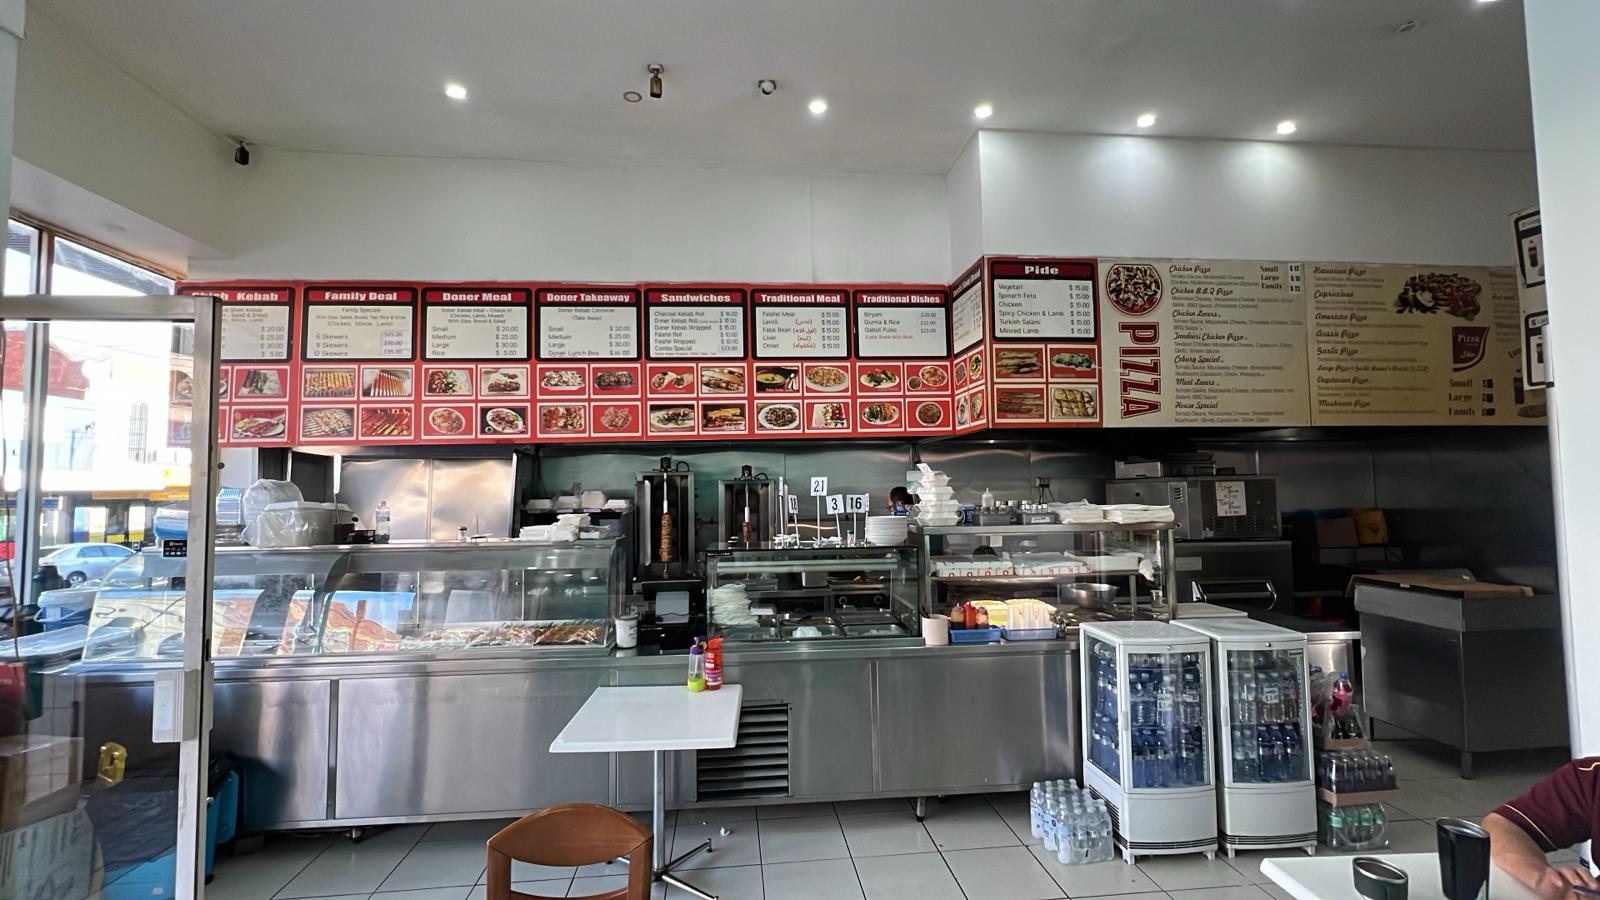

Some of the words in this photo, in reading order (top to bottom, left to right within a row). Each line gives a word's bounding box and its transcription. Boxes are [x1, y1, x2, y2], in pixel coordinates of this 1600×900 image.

[1024, 266, 1059, 274] Pide
[1171, 287, 1194, 295] Chicken
[325, 292, 366, 301] Family
[443, 293, 480, 301] Doner
[580, 294, 629, 302] Takeaway
[1202, 333, 1225, 341] Chicken
[1227, 333, 1243, 341] Pizza
[1198, 356, 1220, 364] Special
[1120, 322, 1161, 418] PIZZA
[814, 480, 824, 492] 21
[832, 498, 838, 510] 3
[850, 497, 862, 509] 16
